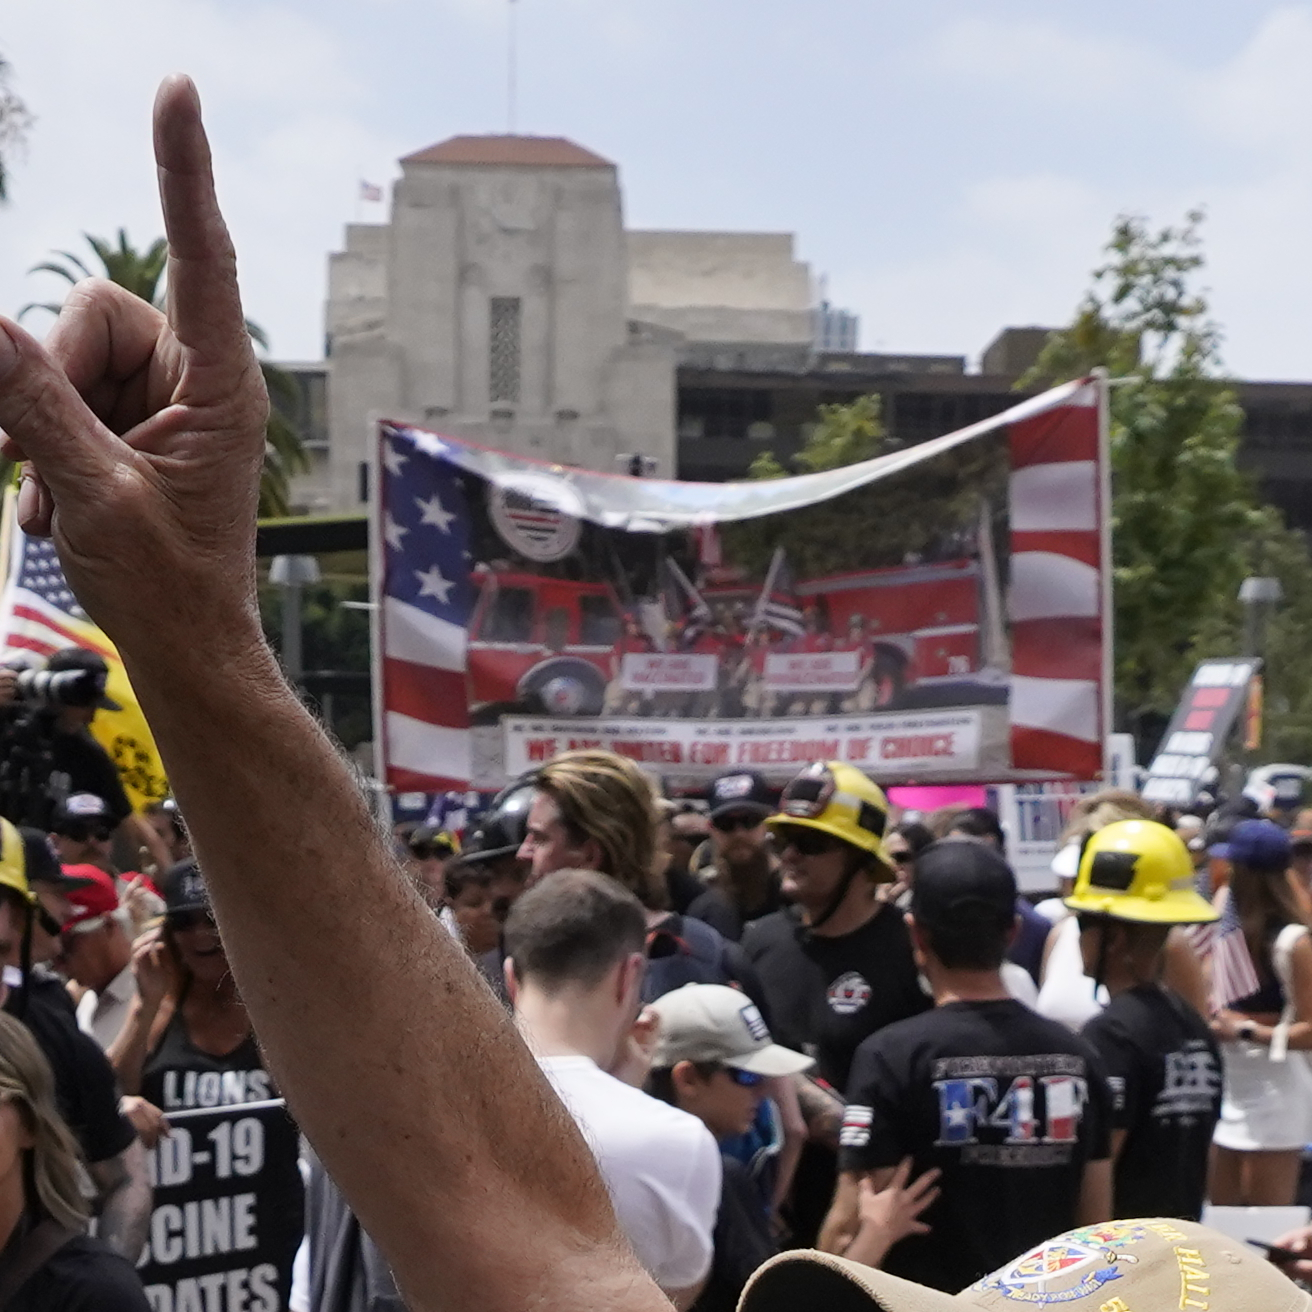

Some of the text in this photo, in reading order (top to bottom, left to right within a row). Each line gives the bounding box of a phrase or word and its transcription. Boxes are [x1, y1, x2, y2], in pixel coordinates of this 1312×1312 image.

[737, 738, 840, 763] FREEDOM
[879, 732, 956, 759] CHOICE
[163, 1069, 271, 1107] LIONS
[136, 1193, 259, 1268] CINE
[1172, 1245, 1210, 1311] HALL
